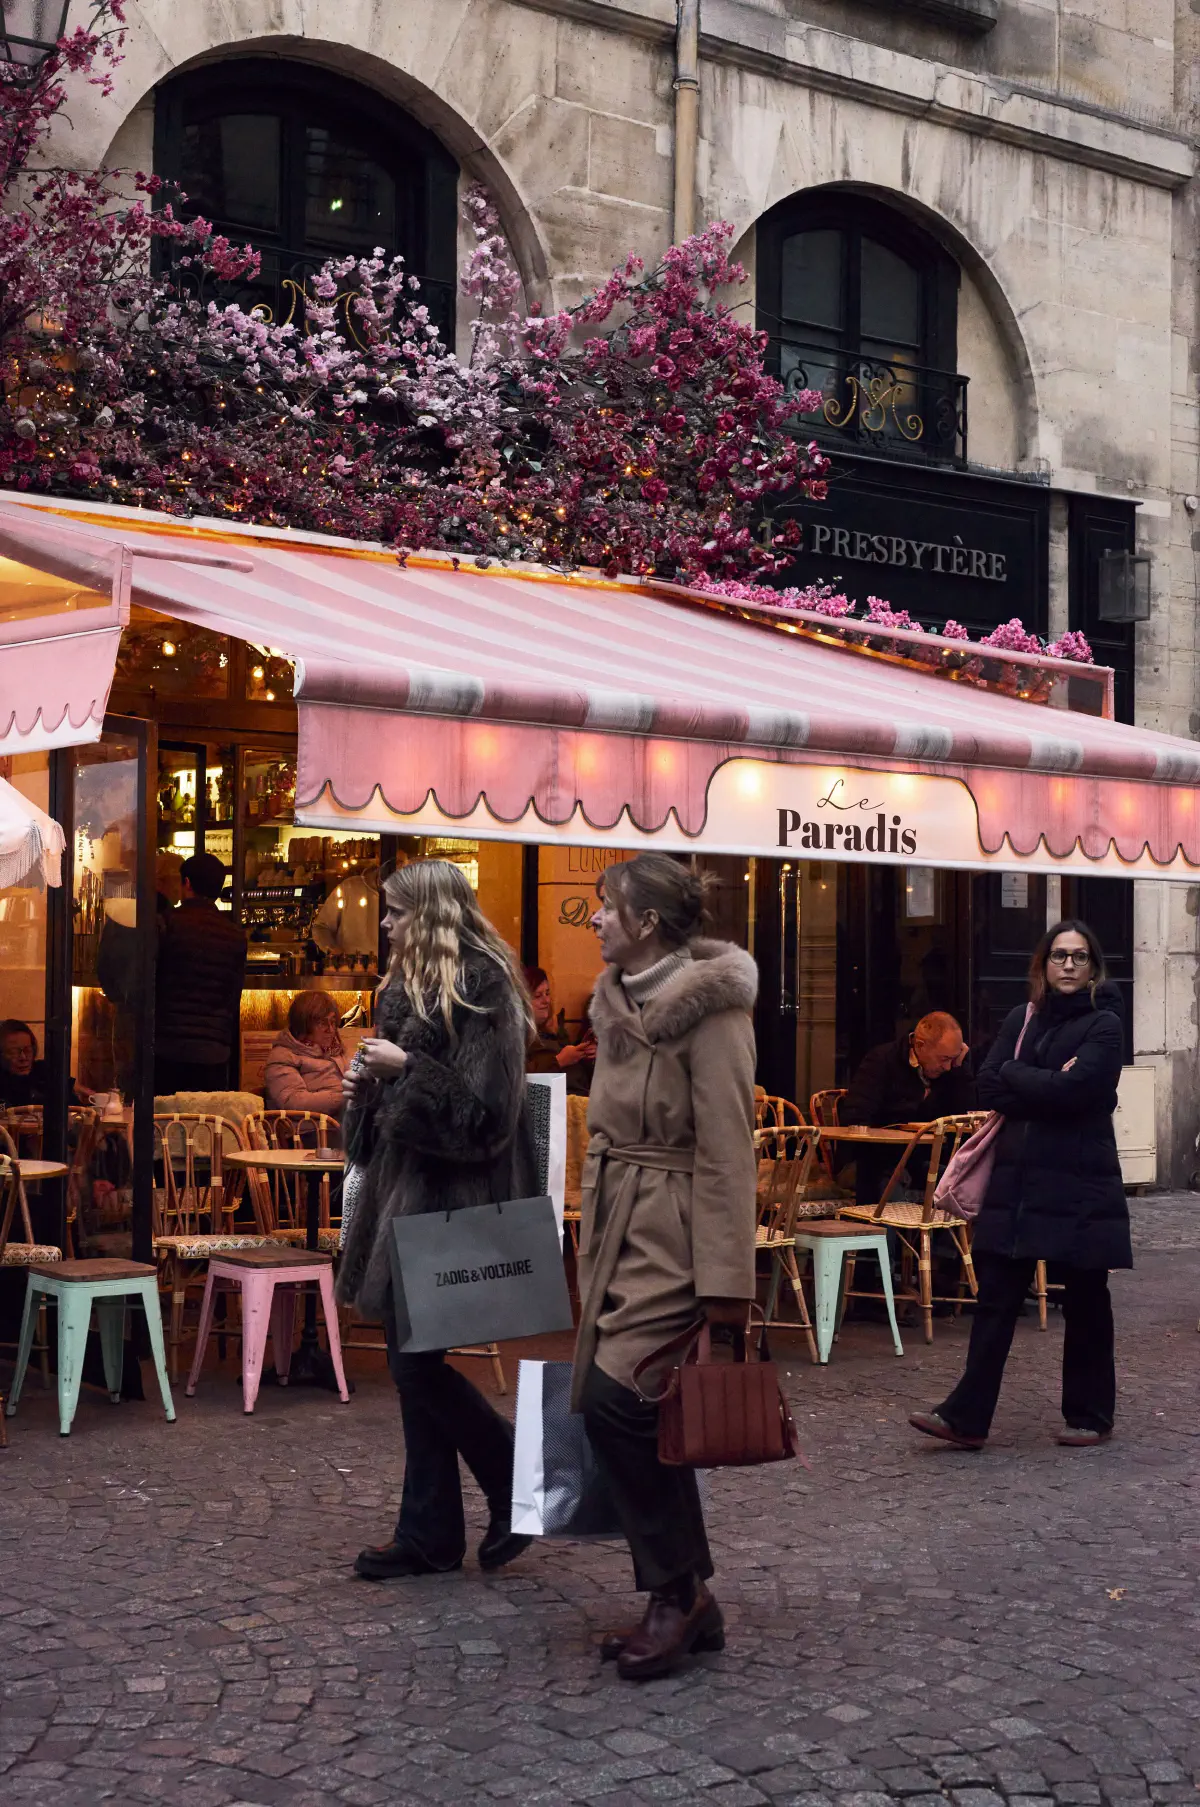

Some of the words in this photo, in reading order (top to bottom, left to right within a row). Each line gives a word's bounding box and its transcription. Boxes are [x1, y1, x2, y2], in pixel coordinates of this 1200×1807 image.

[761, 517, 804, 552] L
[811, 524, 1007, 582] PRESBYTÈRE
[816, 778, 885, 811] Le
[776, 808, 917, 855] Paradis
